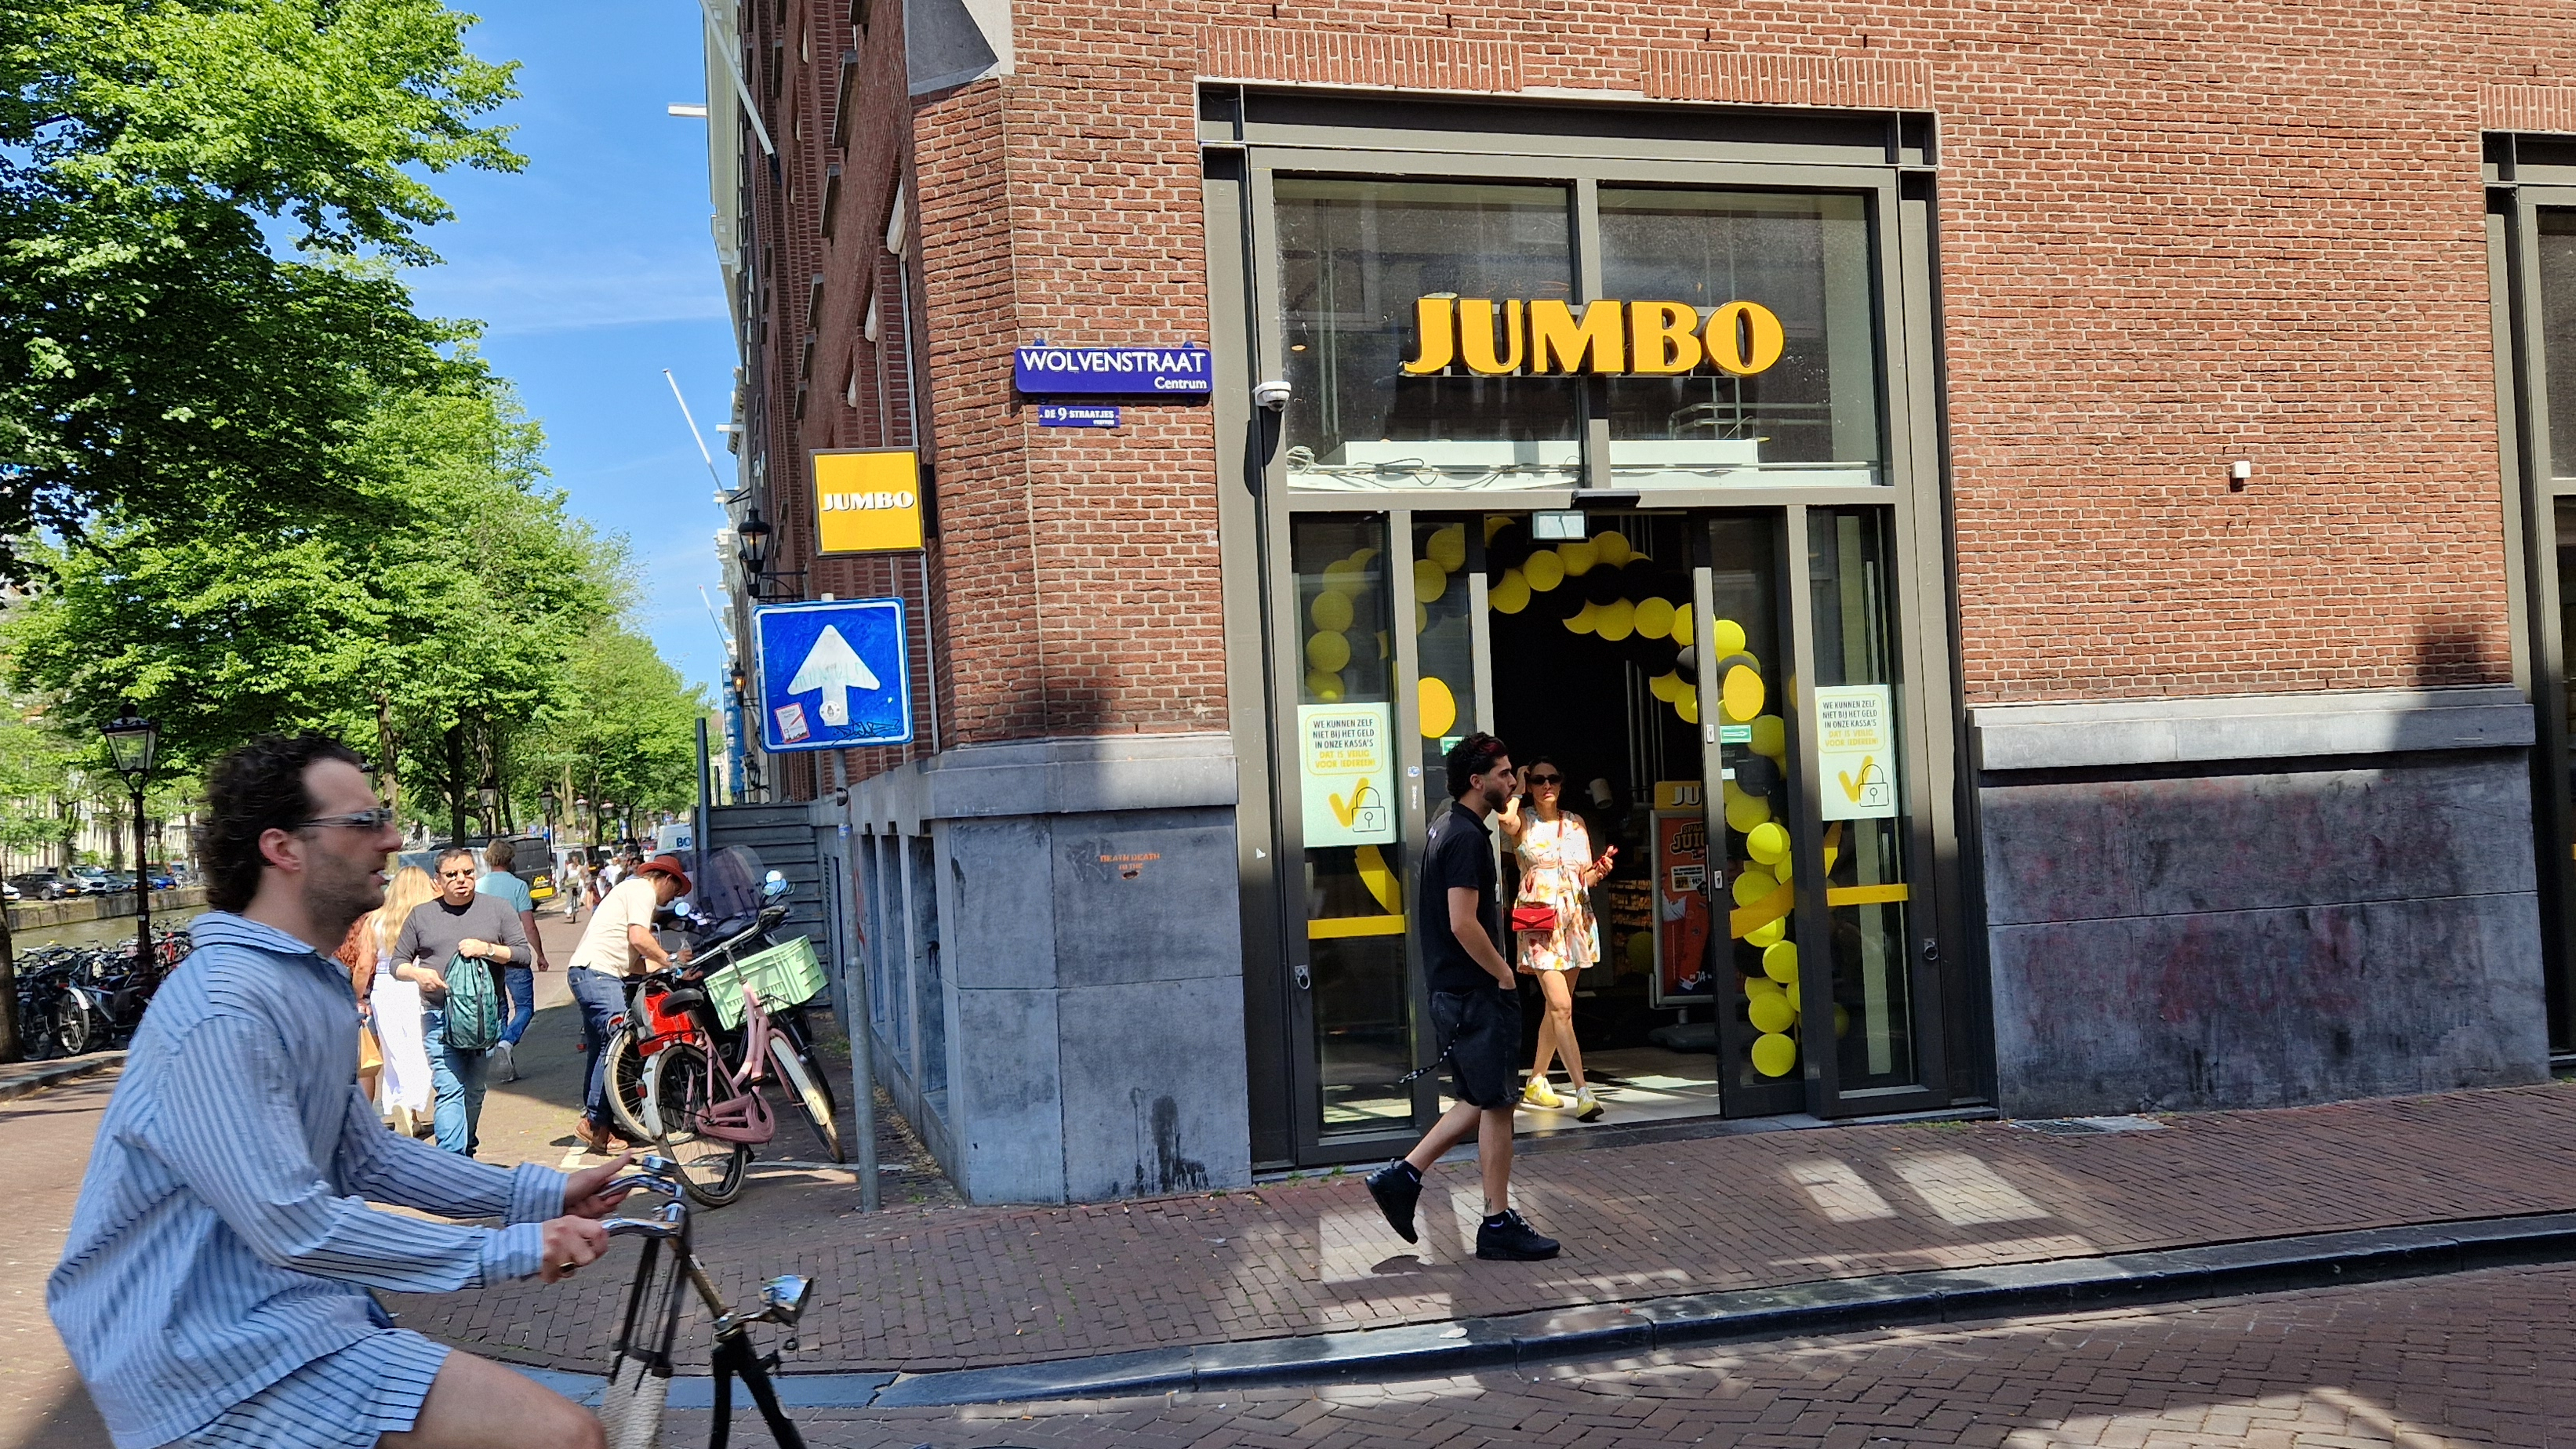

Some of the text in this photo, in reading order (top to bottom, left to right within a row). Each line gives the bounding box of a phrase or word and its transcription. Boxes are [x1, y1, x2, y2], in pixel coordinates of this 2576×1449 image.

[1401, 298, 1786, 376] JUMBO
[1020, 350, 1206, 373] WOLVENSTRAAT
[1154, 376, 1208, 390] Centrum
[1044, 407, 1114, 421] DE 9 STRAATJES
[823, 492, 914, 511] JUMBO
[1822, 701, 1833, 710] WE
[1834, 700, 1861, 709] KUNNEN
[1822, 709, 1877, 719] NIET BIJ HET GELD
[1313, 718, 1373, 728] WE KUNNEN ZELF
[1833, 720, 1849, 728] ONZE
[1851, 718, 1877, 728] KASSA'S
[1313, 728, 1375, 739] NIET BIJ HET GELD
[1314, 739, 1374, 749] IN ONZE KASSA'S
